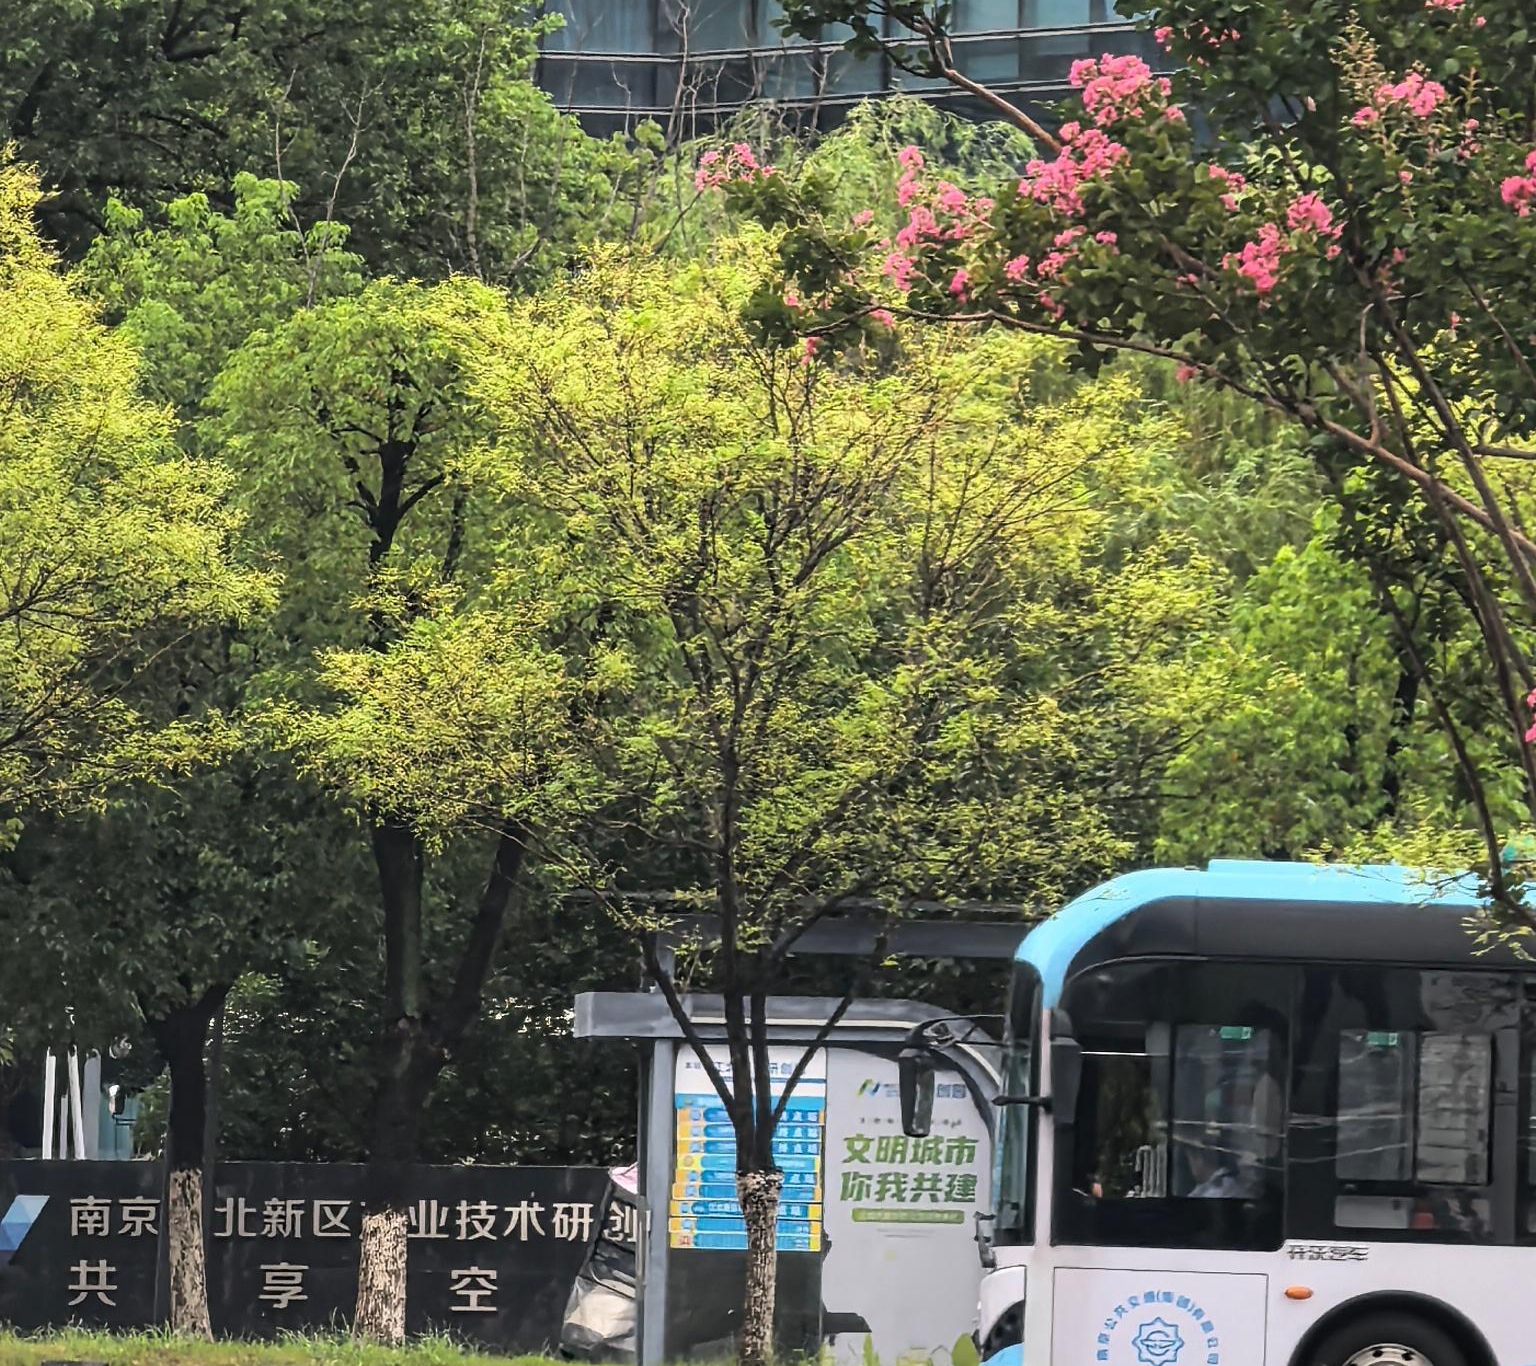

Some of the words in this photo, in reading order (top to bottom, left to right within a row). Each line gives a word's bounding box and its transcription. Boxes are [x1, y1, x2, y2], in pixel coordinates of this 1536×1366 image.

[842, 1133, 979, 1166] 文明城市
[840, 1171, 977, 1203] 你我共建
[69, 1194, 640, 1242] 南京北新区业技术研创
